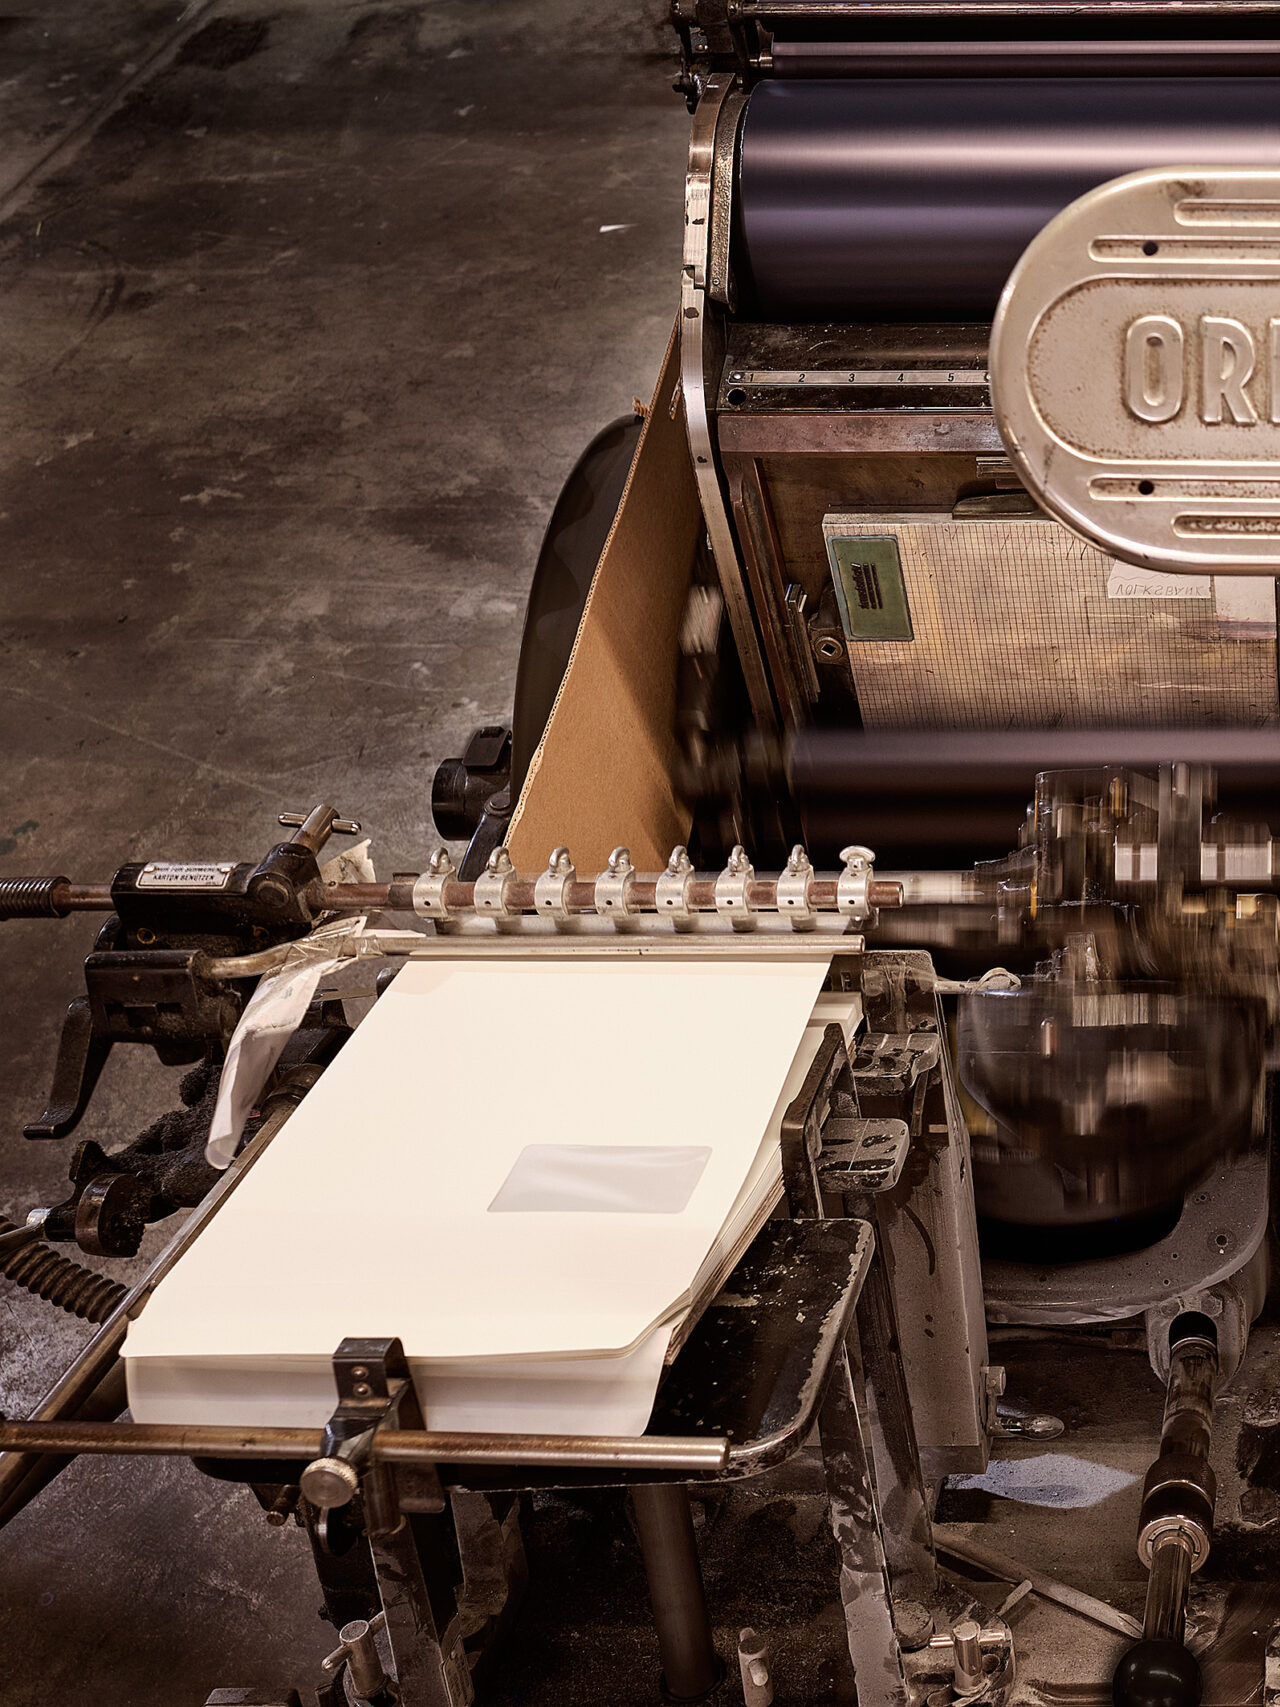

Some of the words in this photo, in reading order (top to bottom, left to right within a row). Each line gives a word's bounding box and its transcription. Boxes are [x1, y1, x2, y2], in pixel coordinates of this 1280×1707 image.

[749, 373, 755, 383] 1
[798, 373, 806, 383] 2
[848, 373, 855, 383] 3
[897, 373, 904, 383] 4
[947, 373, 955, 383] 5
